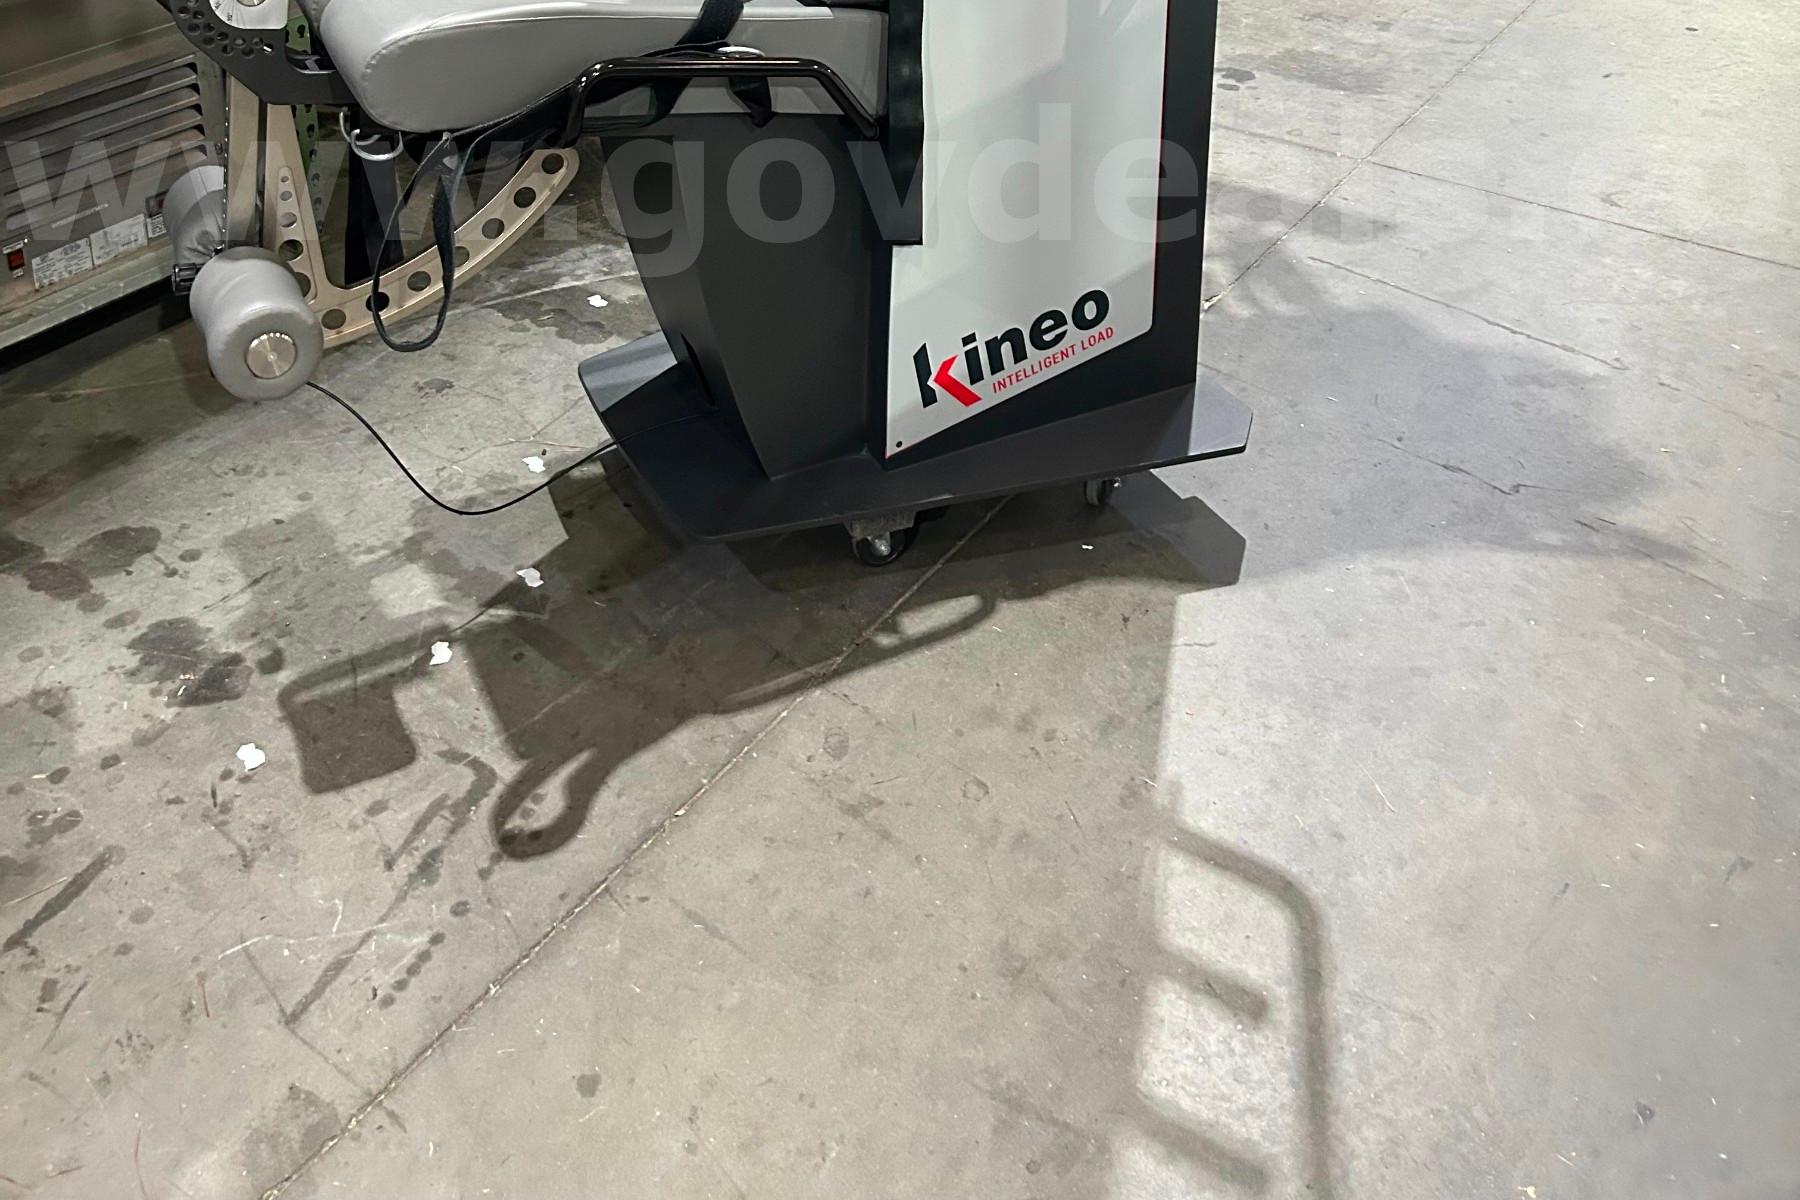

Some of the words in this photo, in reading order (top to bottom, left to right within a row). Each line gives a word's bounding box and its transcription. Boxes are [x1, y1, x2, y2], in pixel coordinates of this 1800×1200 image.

[912, 289, 1110, 408] kineo
[992, 344, 1077, 394] INTELLIGENT
[1081, 326, 1115, 351] LOAD
